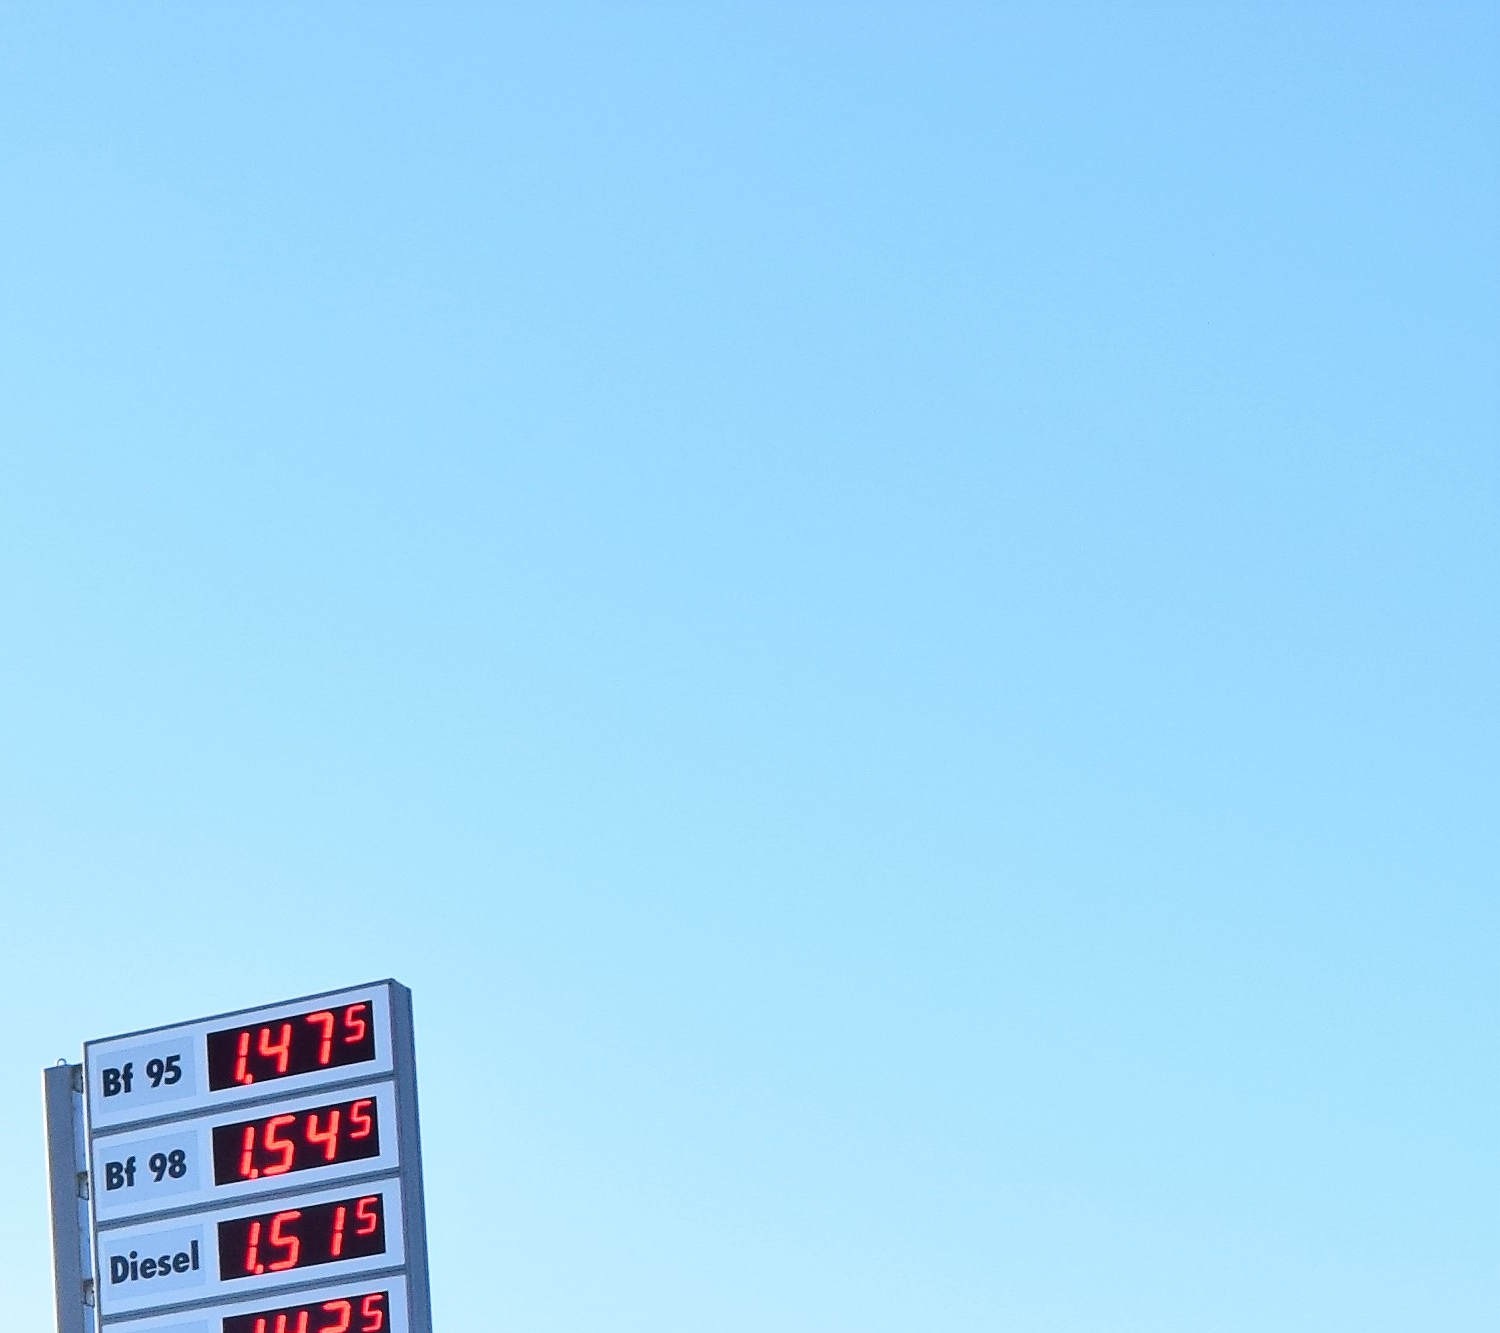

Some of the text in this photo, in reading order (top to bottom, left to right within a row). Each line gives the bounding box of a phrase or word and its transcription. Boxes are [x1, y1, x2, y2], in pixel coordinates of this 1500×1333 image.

[102, 1054, 183, 1099] Bf 95
[105, 1149, 187, 1191] Bf 98
[110, 1239, 200, 1286] Diesel
